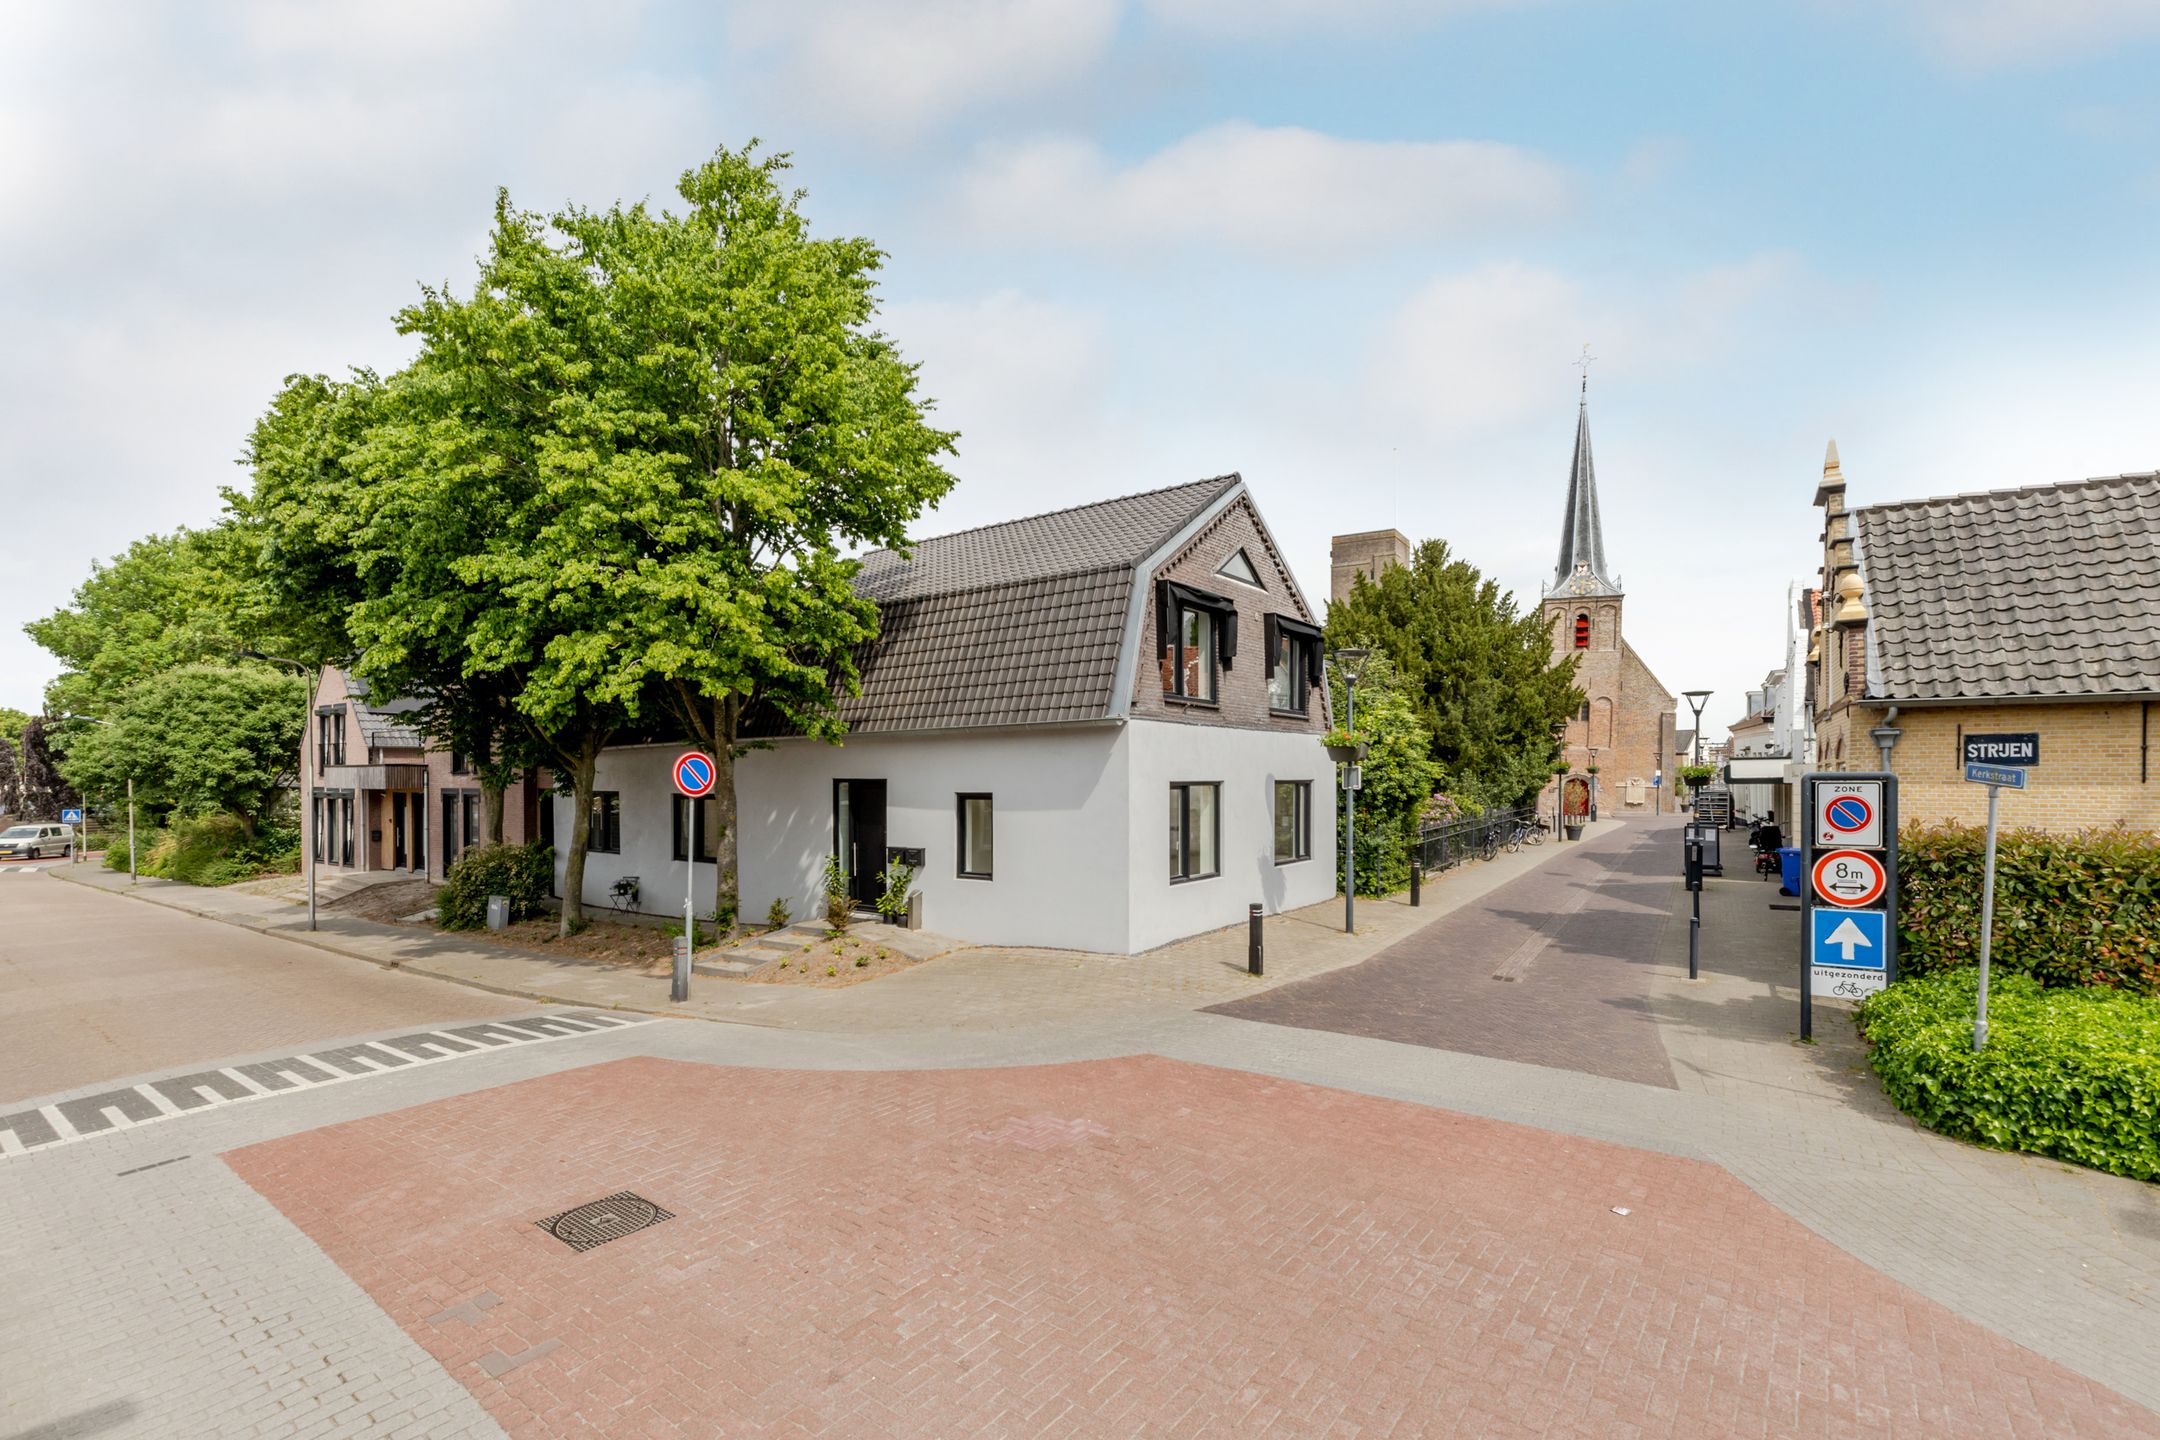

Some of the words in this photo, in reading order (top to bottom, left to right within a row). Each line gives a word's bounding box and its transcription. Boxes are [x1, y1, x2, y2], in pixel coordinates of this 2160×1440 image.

[1971, 768, 2017, 783] Kerkstraat
[1836, 862, 1848, 878] 8
[1851, 871, 1863, 879] m
[1814, 969, 1883, 981] uitgezonderd
